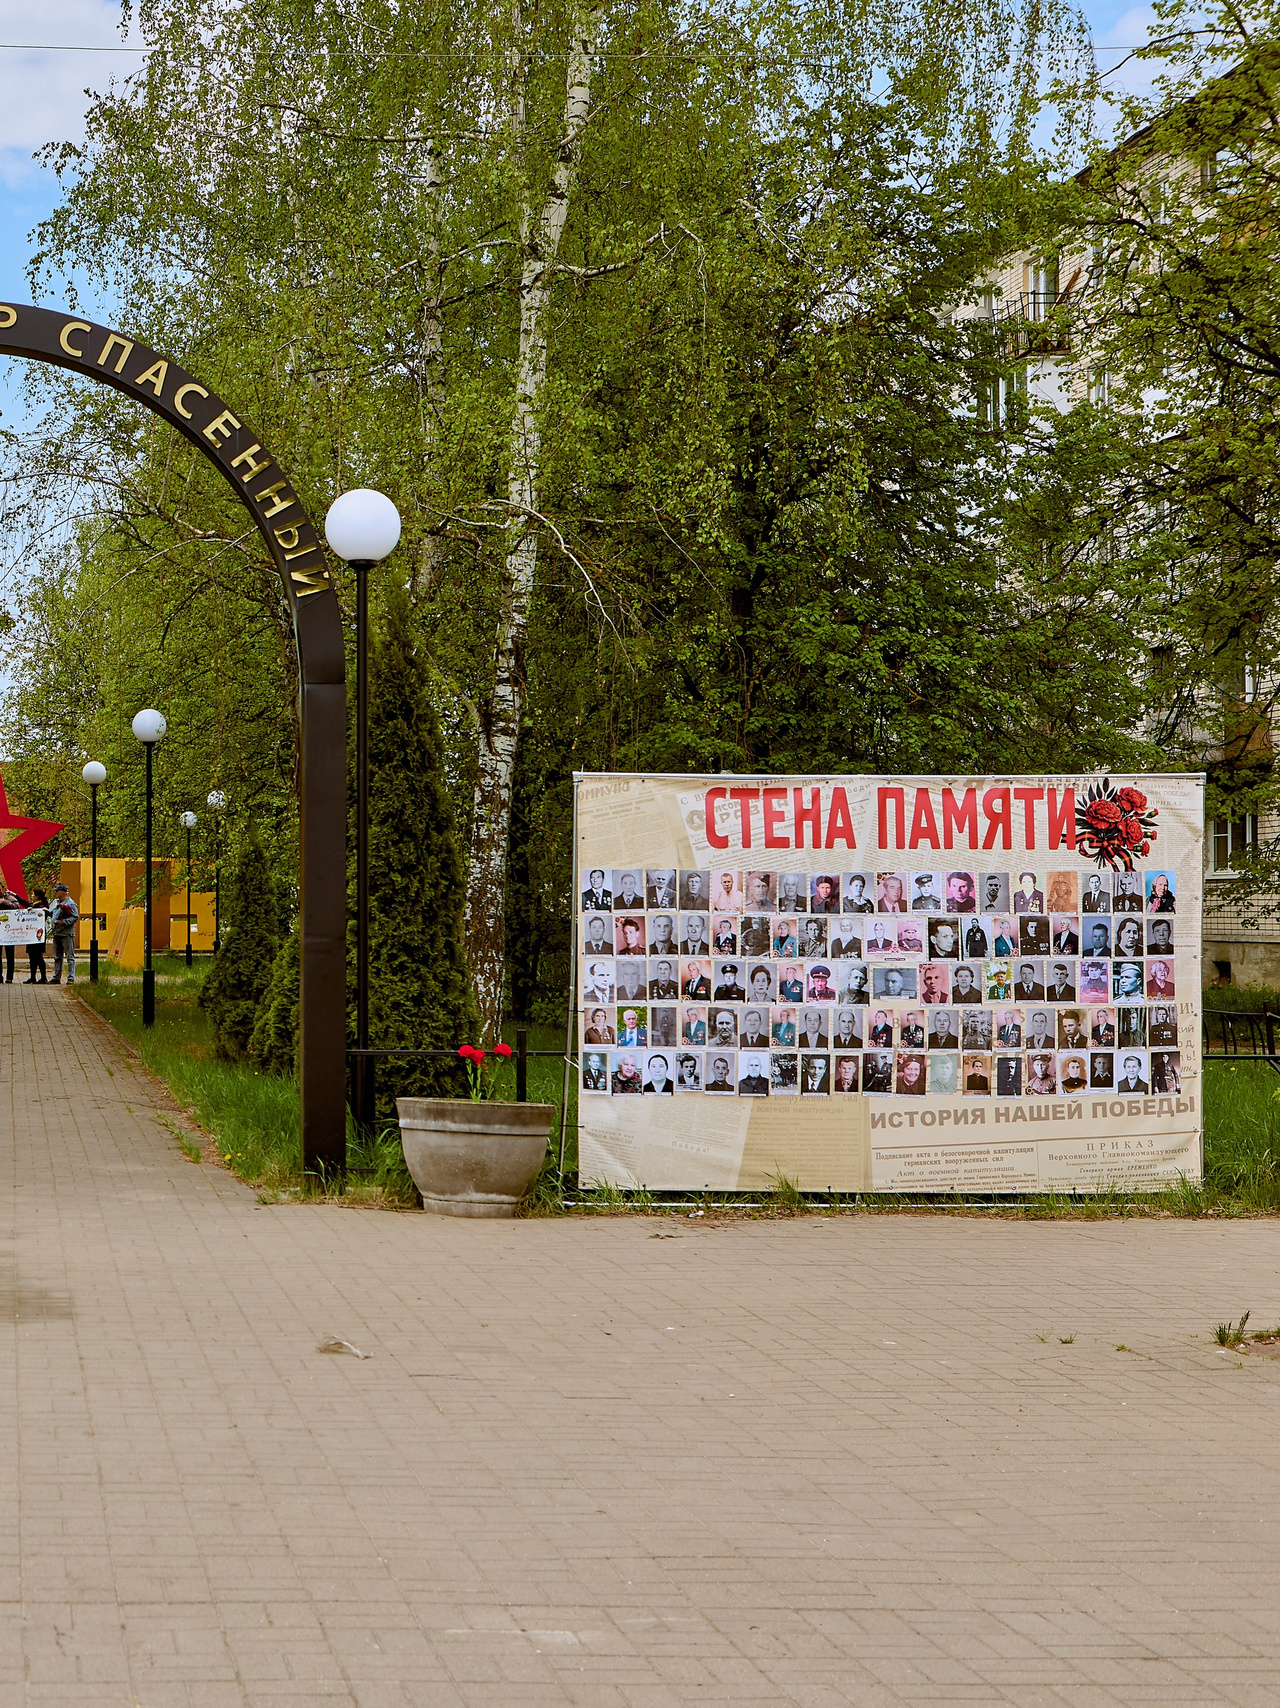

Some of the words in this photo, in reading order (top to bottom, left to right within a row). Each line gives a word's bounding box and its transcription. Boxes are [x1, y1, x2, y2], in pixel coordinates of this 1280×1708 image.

[57, 320, 335, 598] СПАСЕННЫЙ
[705, 787, 856, 849] СТЕНА
[877, 787, 1076, 850] ПАМЯТИ
[871, 1108, 986, 1129] ИСТОРИЯ
[994, 1100, 1083, 1123] НАШЕЙ
[1091, 1096, 1195, 1119] ПОБЕДЫ
[1086, 1140, 1155, 1151] ПРИКАЗ
[876, 1152, 913, 1160] Подписание
[941, 1148, 991, 1158] безоговорочной
[993, 1147, 1034, 1155] капитуляции
[1048, 1152, 1098, 1161] Верховного
[1102, 1147, 1190, 1159] Главнокомандующего
[904, 1159, 941, 1167] германских
[945, 1157, 989, 1166] вооруженных
[896, 1170, 915, 1178] Акт
[963, 1166, 1015, 1175] капитуляции
